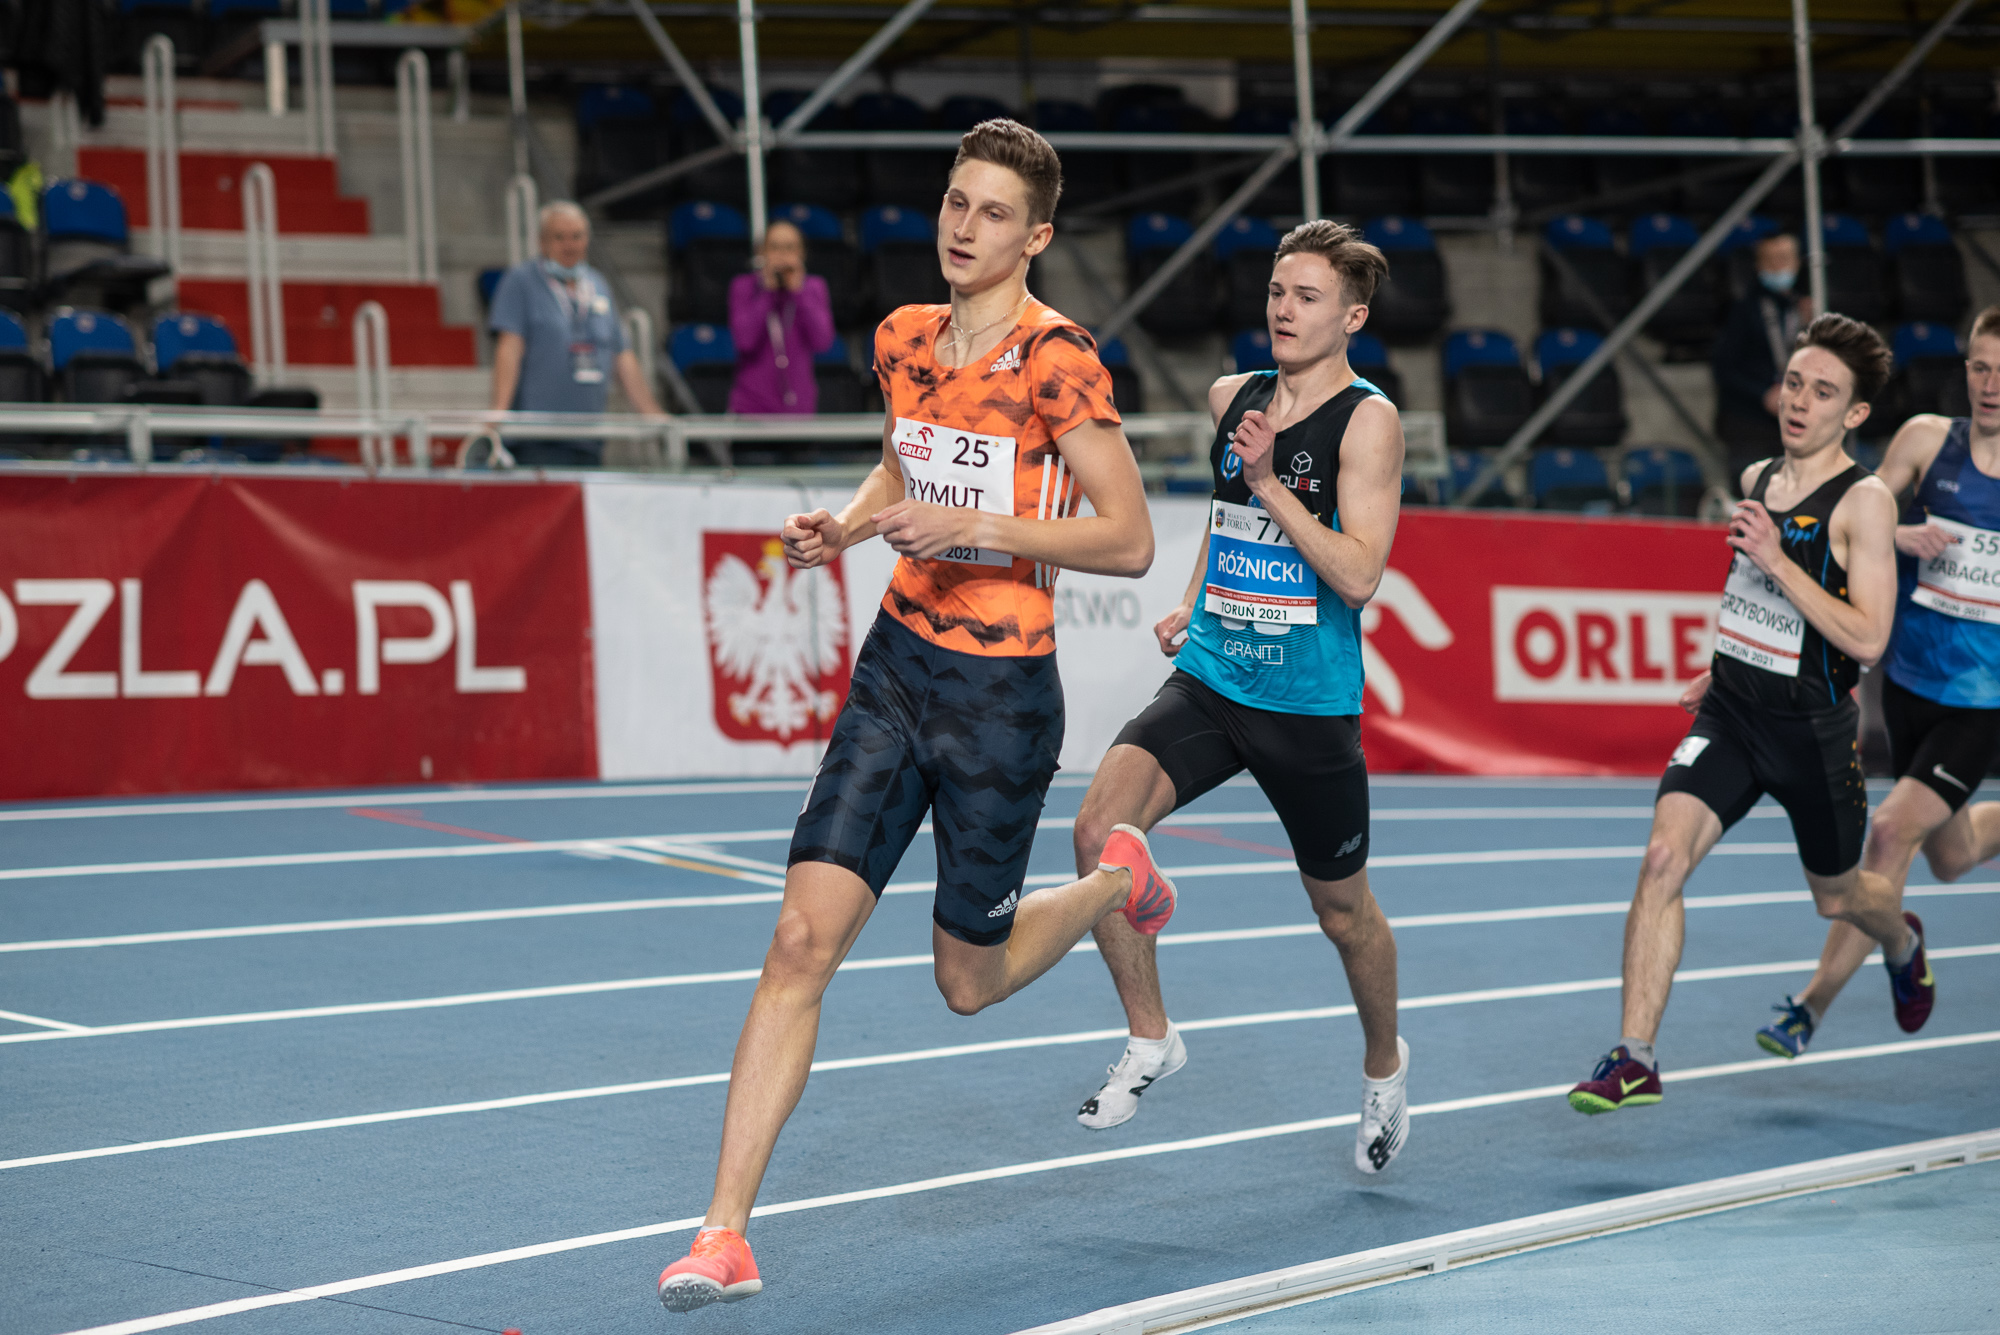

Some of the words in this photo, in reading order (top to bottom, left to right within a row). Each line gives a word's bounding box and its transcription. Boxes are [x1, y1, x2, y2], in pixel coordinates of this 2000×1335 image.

[990, 358, 1021, 373] adidas
[899, 443, 931, 460] ORLEN
[951, 436, 990, 468] 25
[910, 477, 985, 510] RYMUT
[1279, 474, 1322, 493] CUBE
[1226, 518, 1251, 531] TORUŃ
[1257, 515, 1293, 544] 77
[945, 546, 979, 561] 2021
[1217, 549, 1304, 584] RÓŻNICKI
[1221, 601, 1255, 618] TORUŃ
[1258, 607, 1287, 621] 2021
[0, 577, 527, 700] ZLA.PL
[1512, 609, 1710, 683] ORLE
[1751, 650, 1774, 667] 2021
